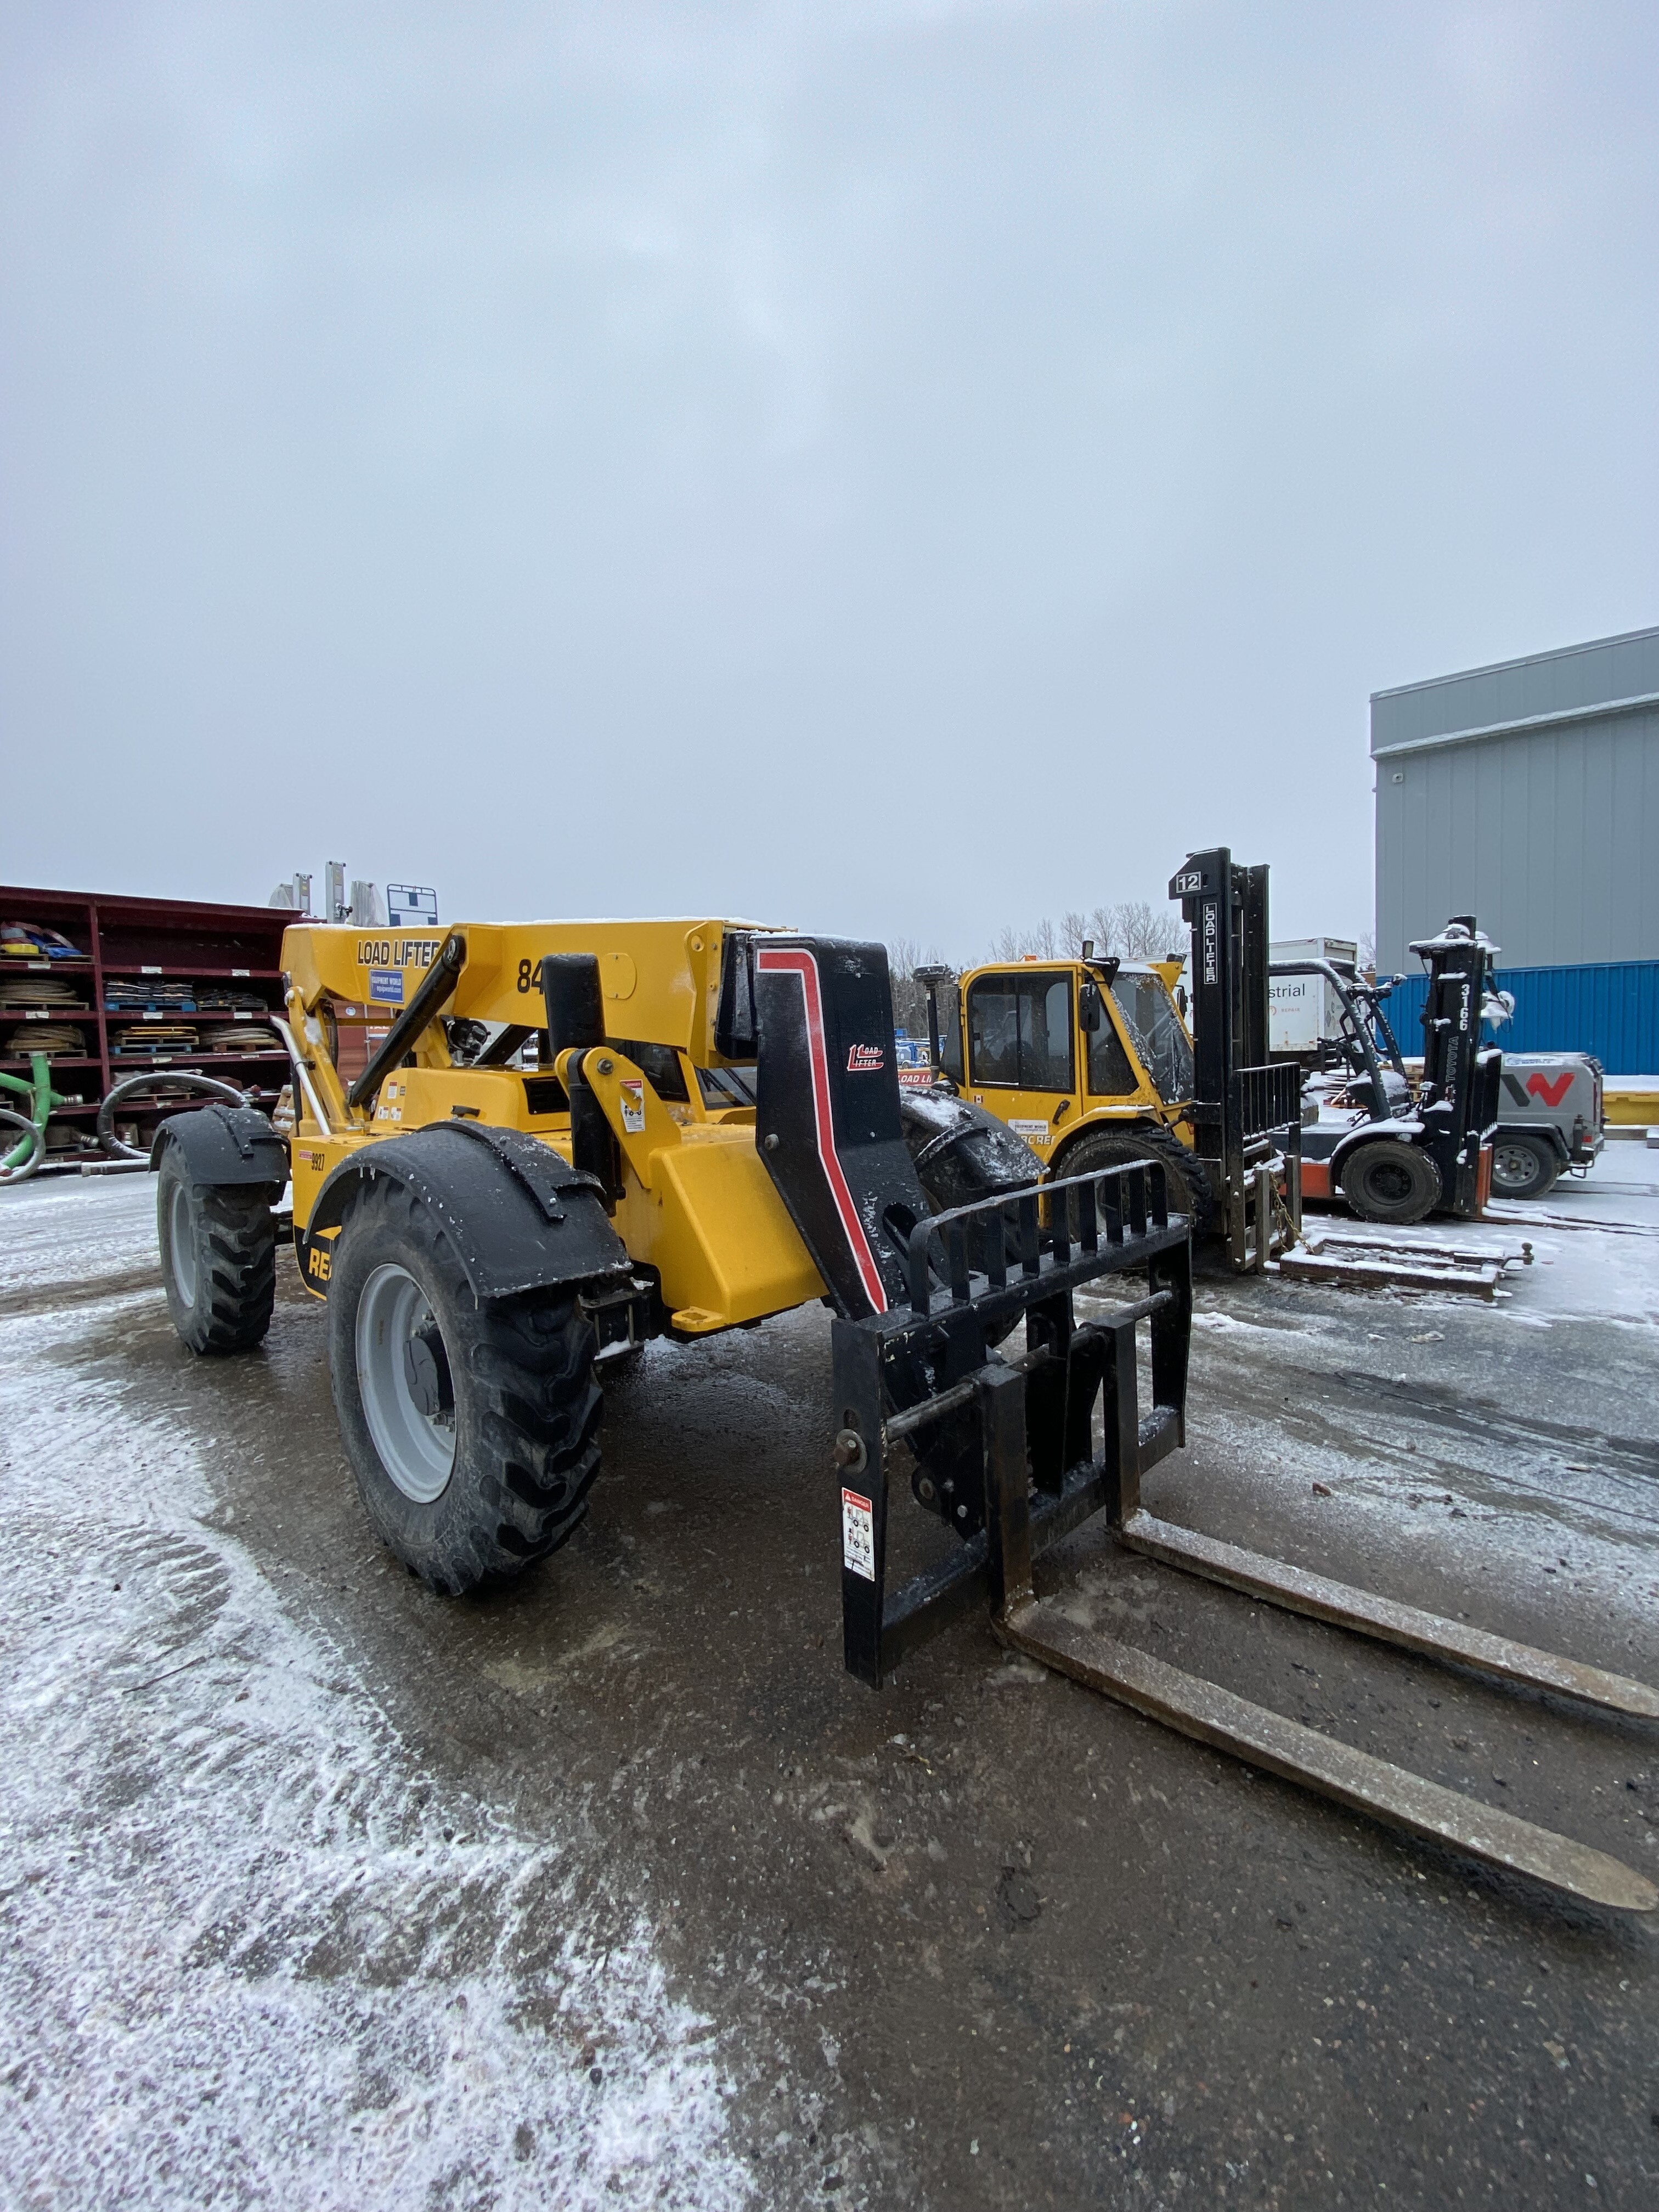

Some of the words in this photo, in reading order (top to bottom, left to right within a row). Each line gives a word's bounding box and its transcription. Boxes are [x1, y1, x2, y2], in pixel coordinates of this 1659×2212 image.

[1178, 874, 1199, 890] 12
[1205, 906, 1215, 936] LOAD
[358, 940, 390, 966] LOAD
[1205, 938, 1215, 983] LIFTER
[1459, 984, 1470, 1031] 3166
[1446, 1036, 1459, 1082] TOYOTA
[311, 1153, 325, 1171] 9927
[851, 1496, 870, 1509] DANGER
